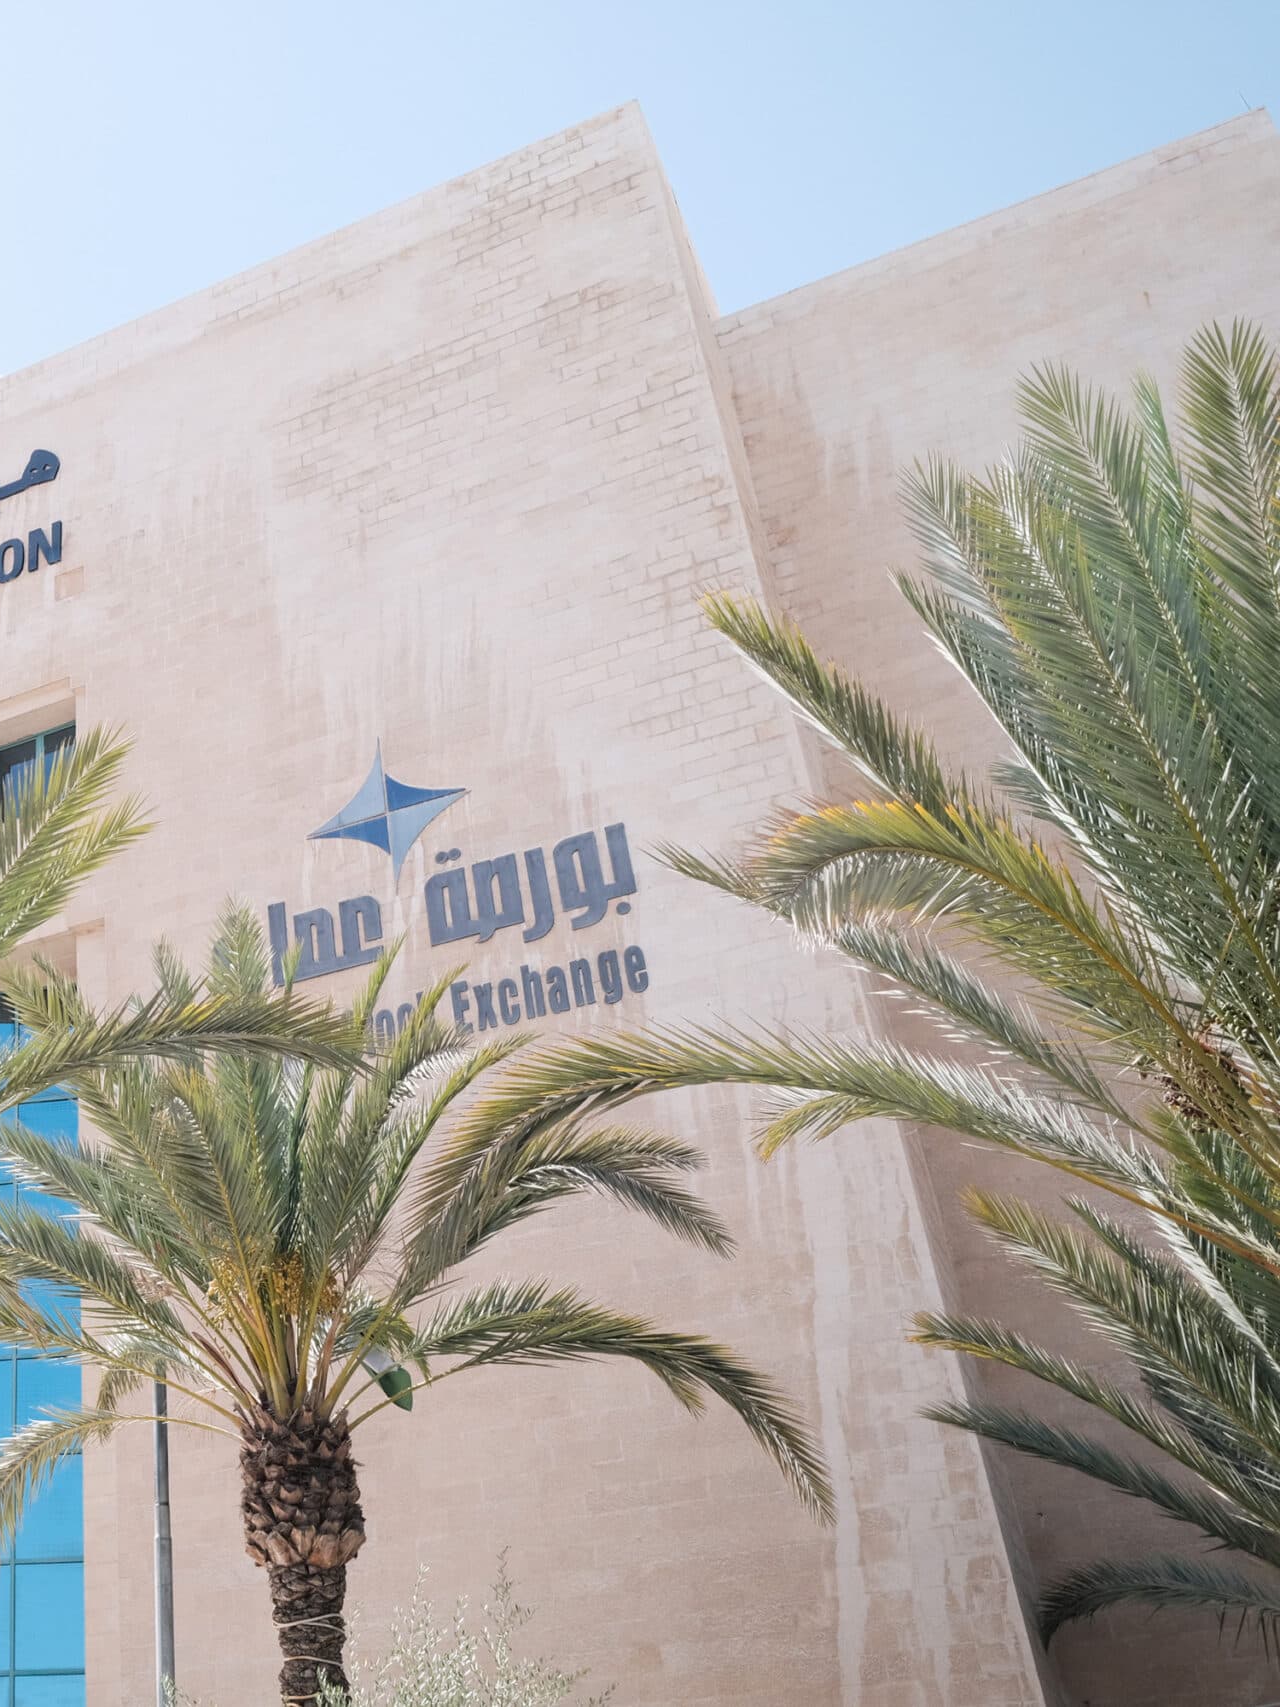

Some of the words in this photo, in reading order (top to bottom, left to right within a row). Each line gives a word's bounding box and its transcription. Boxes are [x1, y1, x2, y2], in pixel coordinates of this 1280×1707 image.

[423, 822, 638, 947] بورصة
[212, 895, 384, 990] عما
[449, 944, 650, 1034] Exchange
